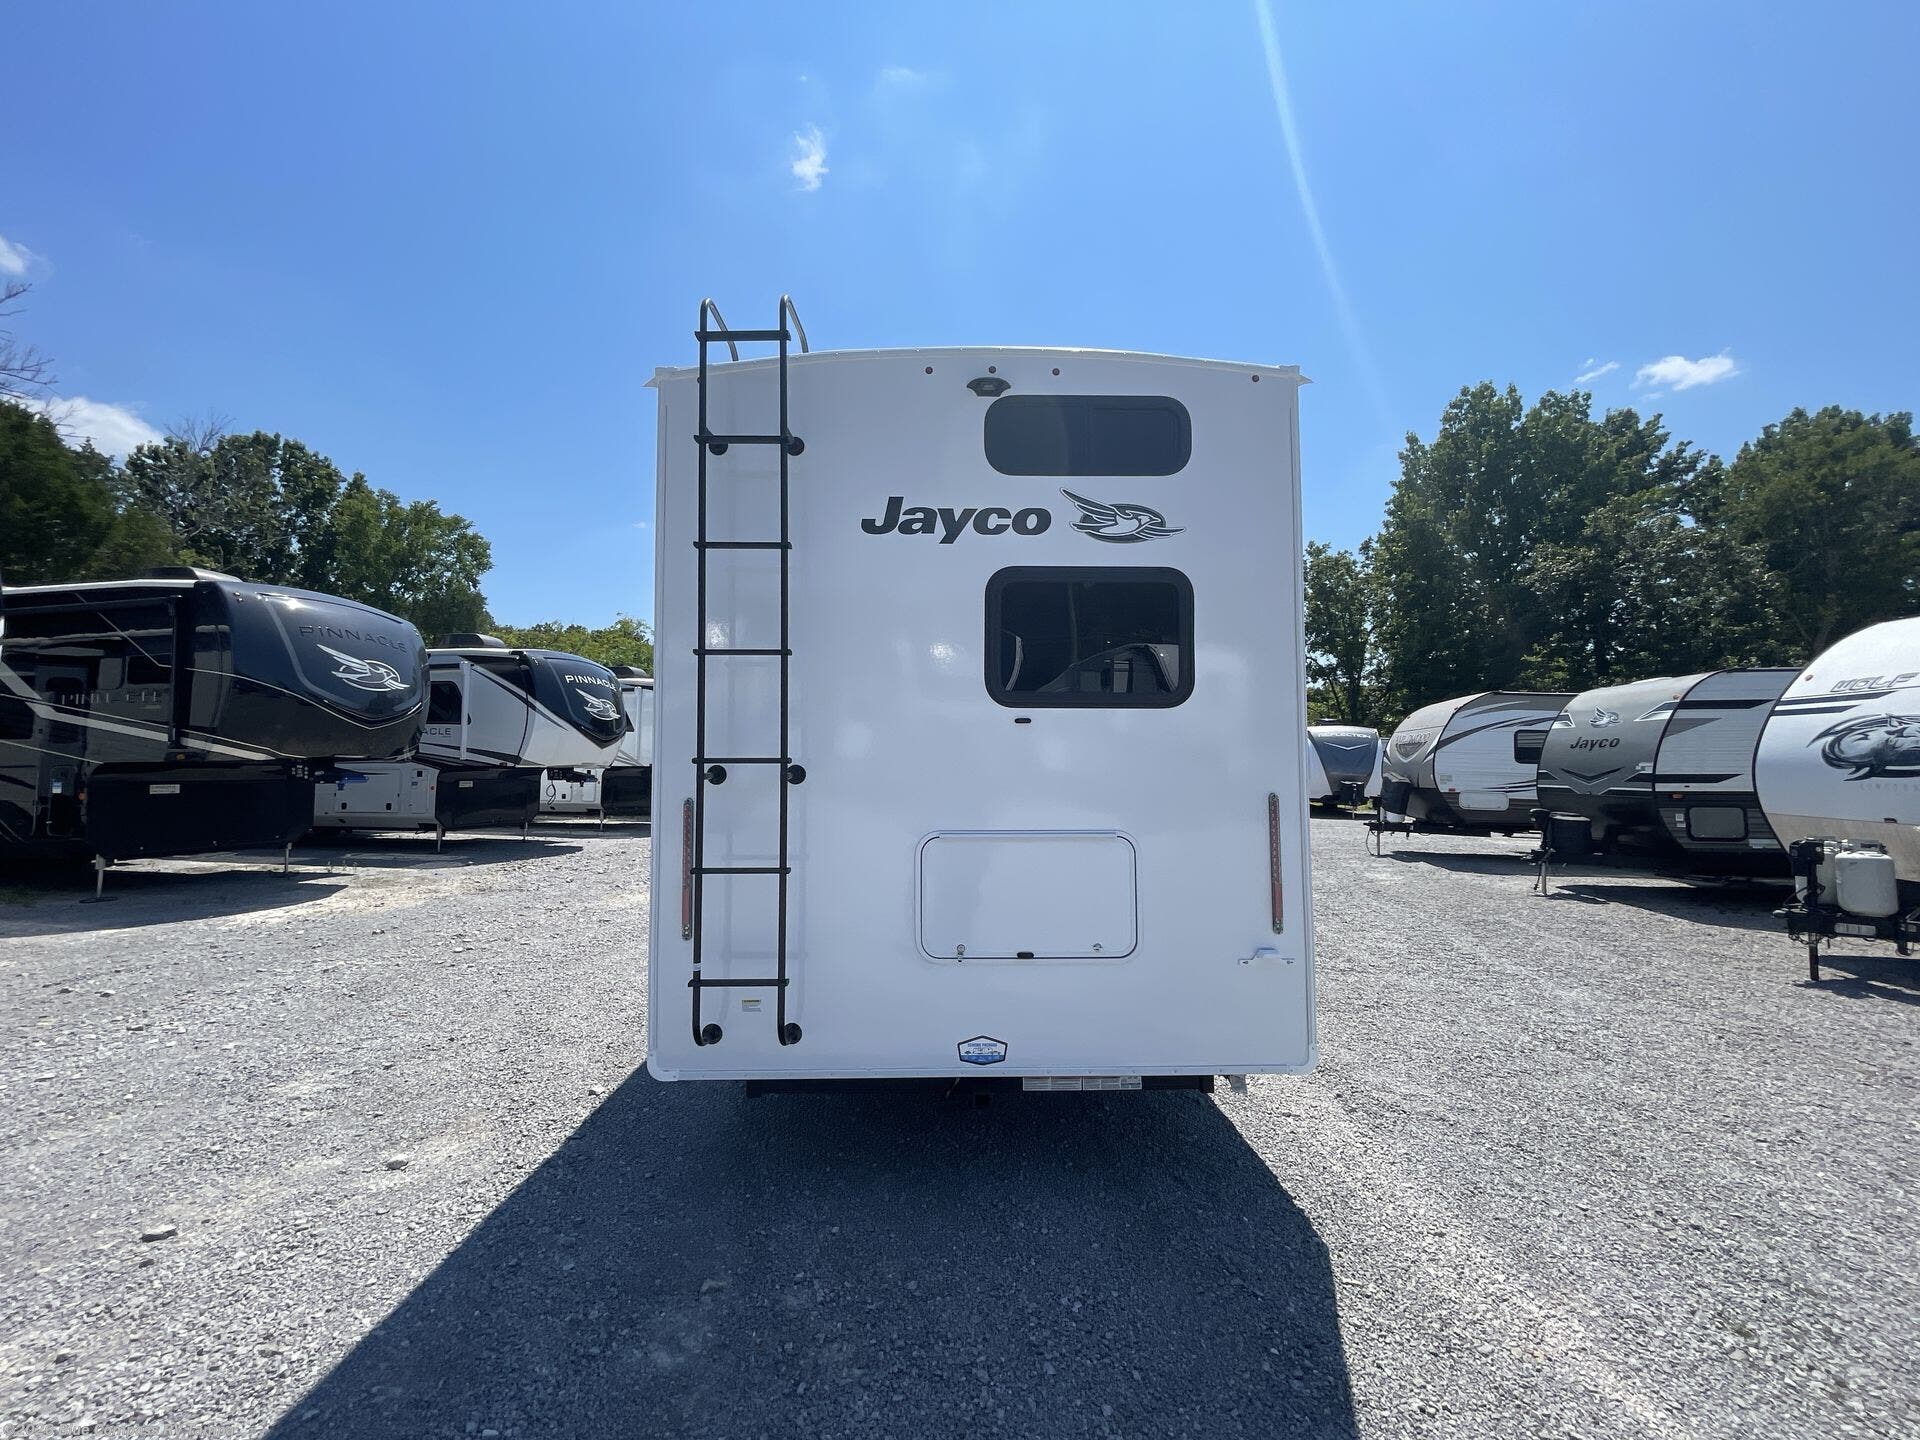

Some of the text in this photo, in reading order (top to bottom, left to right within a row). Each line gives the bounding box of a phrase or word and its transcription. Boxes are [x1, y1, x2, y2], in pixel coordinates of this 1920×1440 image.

[861, 496, 1052, 544] Jayco
[299, 625, 407, 653] PINNACLE
[564, 674, 618, 692] PINNACLE
[1830, 672, 1919, 693] WOLF
[1570, 736, 1621, 752] Jayco
